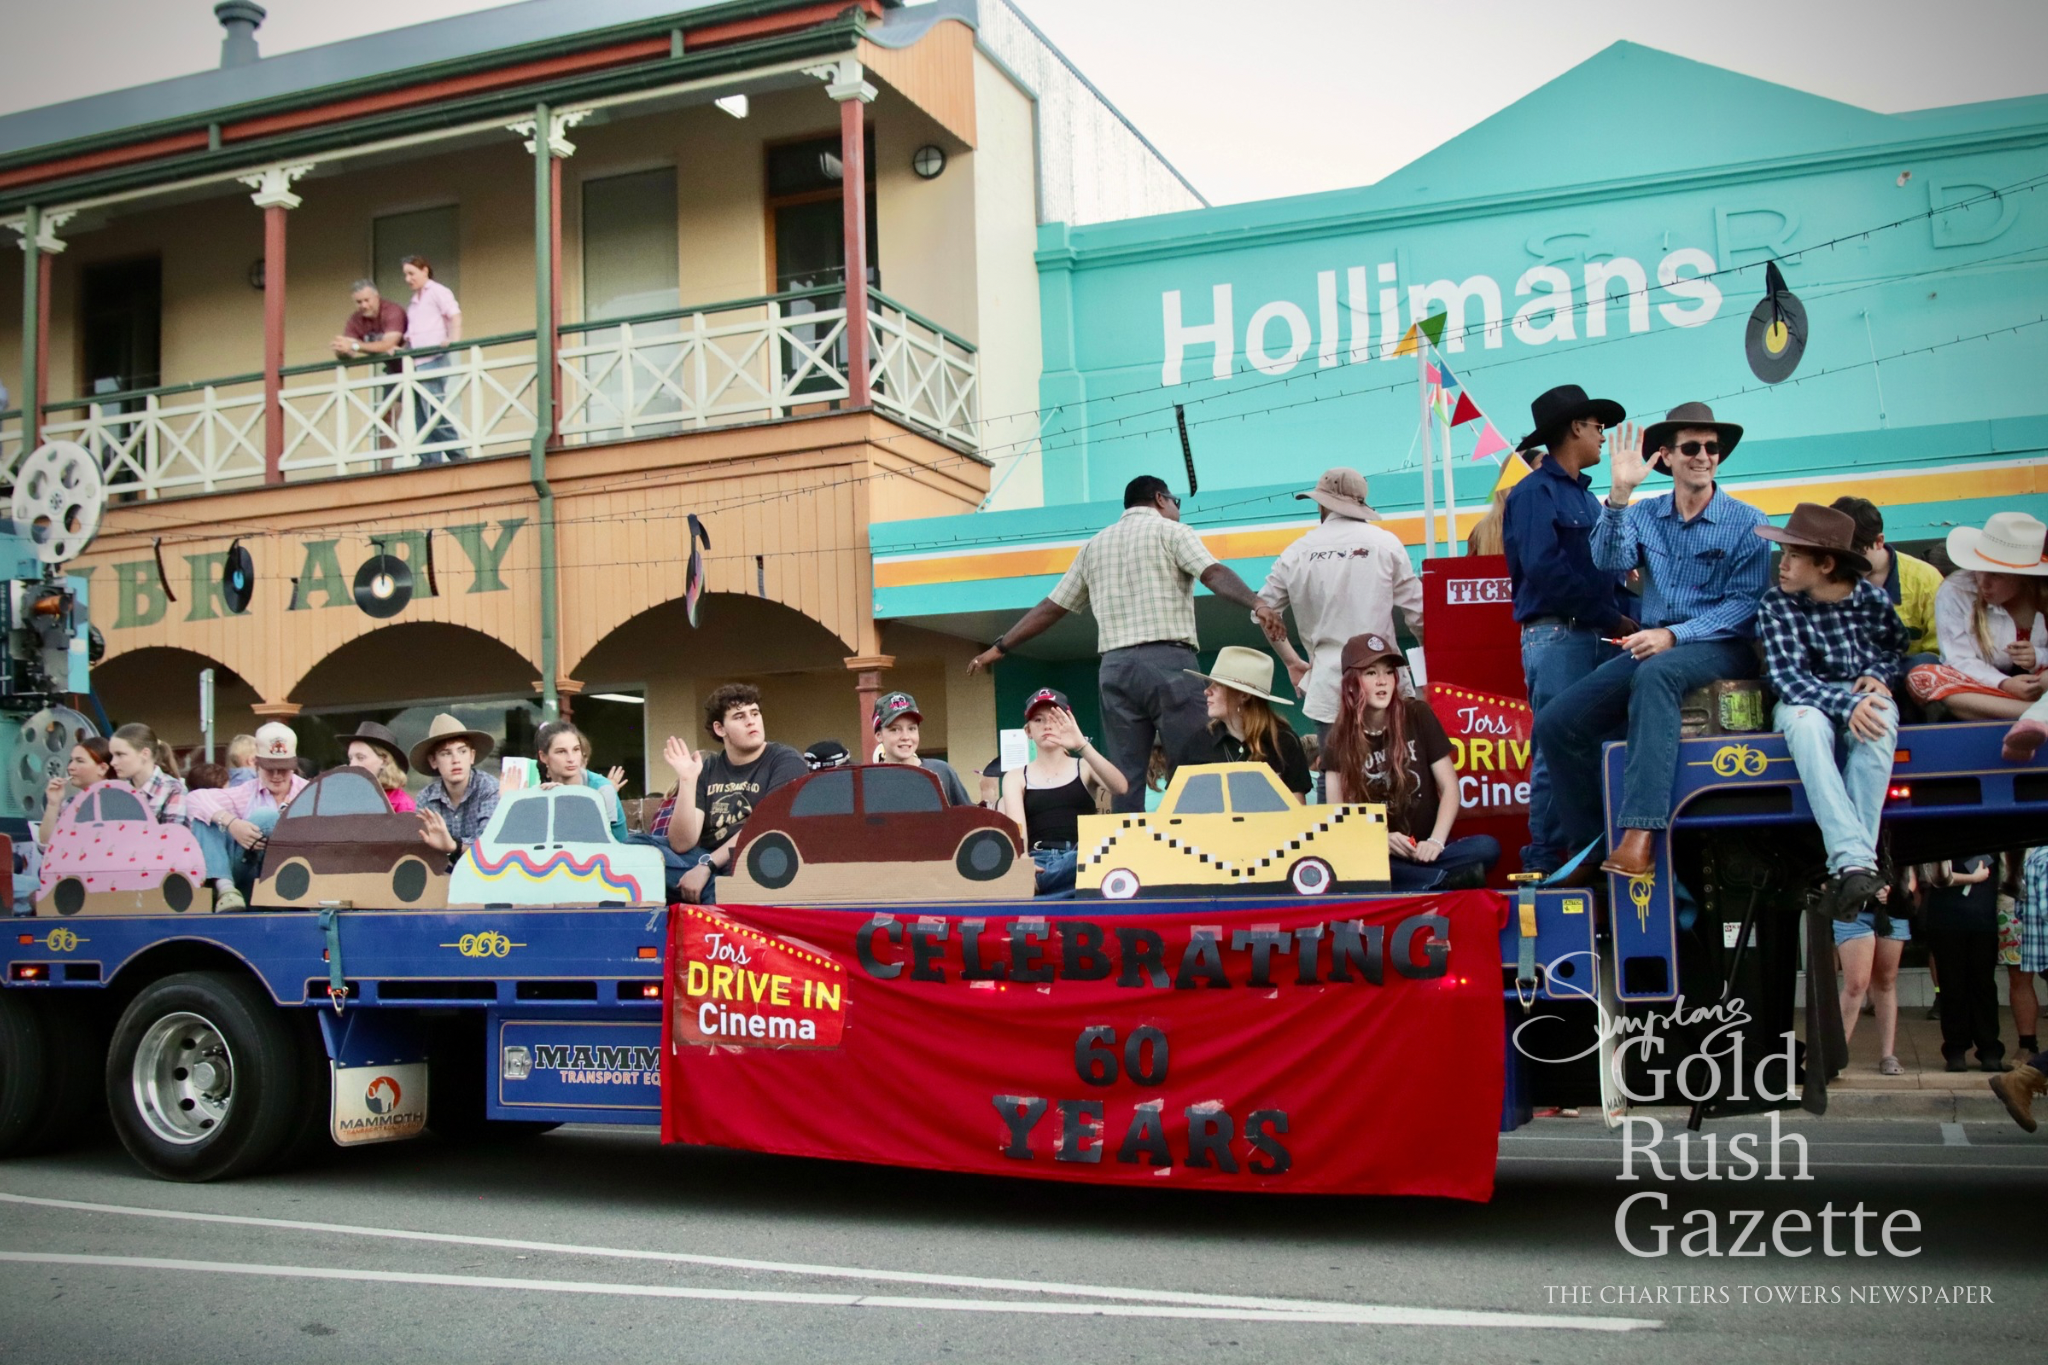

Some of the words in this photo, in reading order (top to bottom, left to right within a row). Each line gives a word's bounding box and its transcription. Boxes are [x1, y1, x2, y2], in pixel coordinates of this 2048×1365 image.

[1161, 247, 1723, 387] Hollimans
[1449, 580, 1512, 602] TICK
[1457, 706, 1512, 735] Tors
[1459, 775, 1531, 809] Cine
[704, 933, 752, 965] Tors
[855, 914, 1451, 990] CELEBRATING
[687, 960, 793, 1006] DRIVE
[803, 979, 841, 1012] IN
[698, 1001, 816, 1040] Cinema
[535, 1044, 662, 1072] MAMM
[1075, 1025, 1169, 1087] 60
[560, 1070, 639, 1085] TRANSPORT
[340, 1111, 424, 1130] MAMMOTH
[992, 1095, 1293, 1175] YEARS
